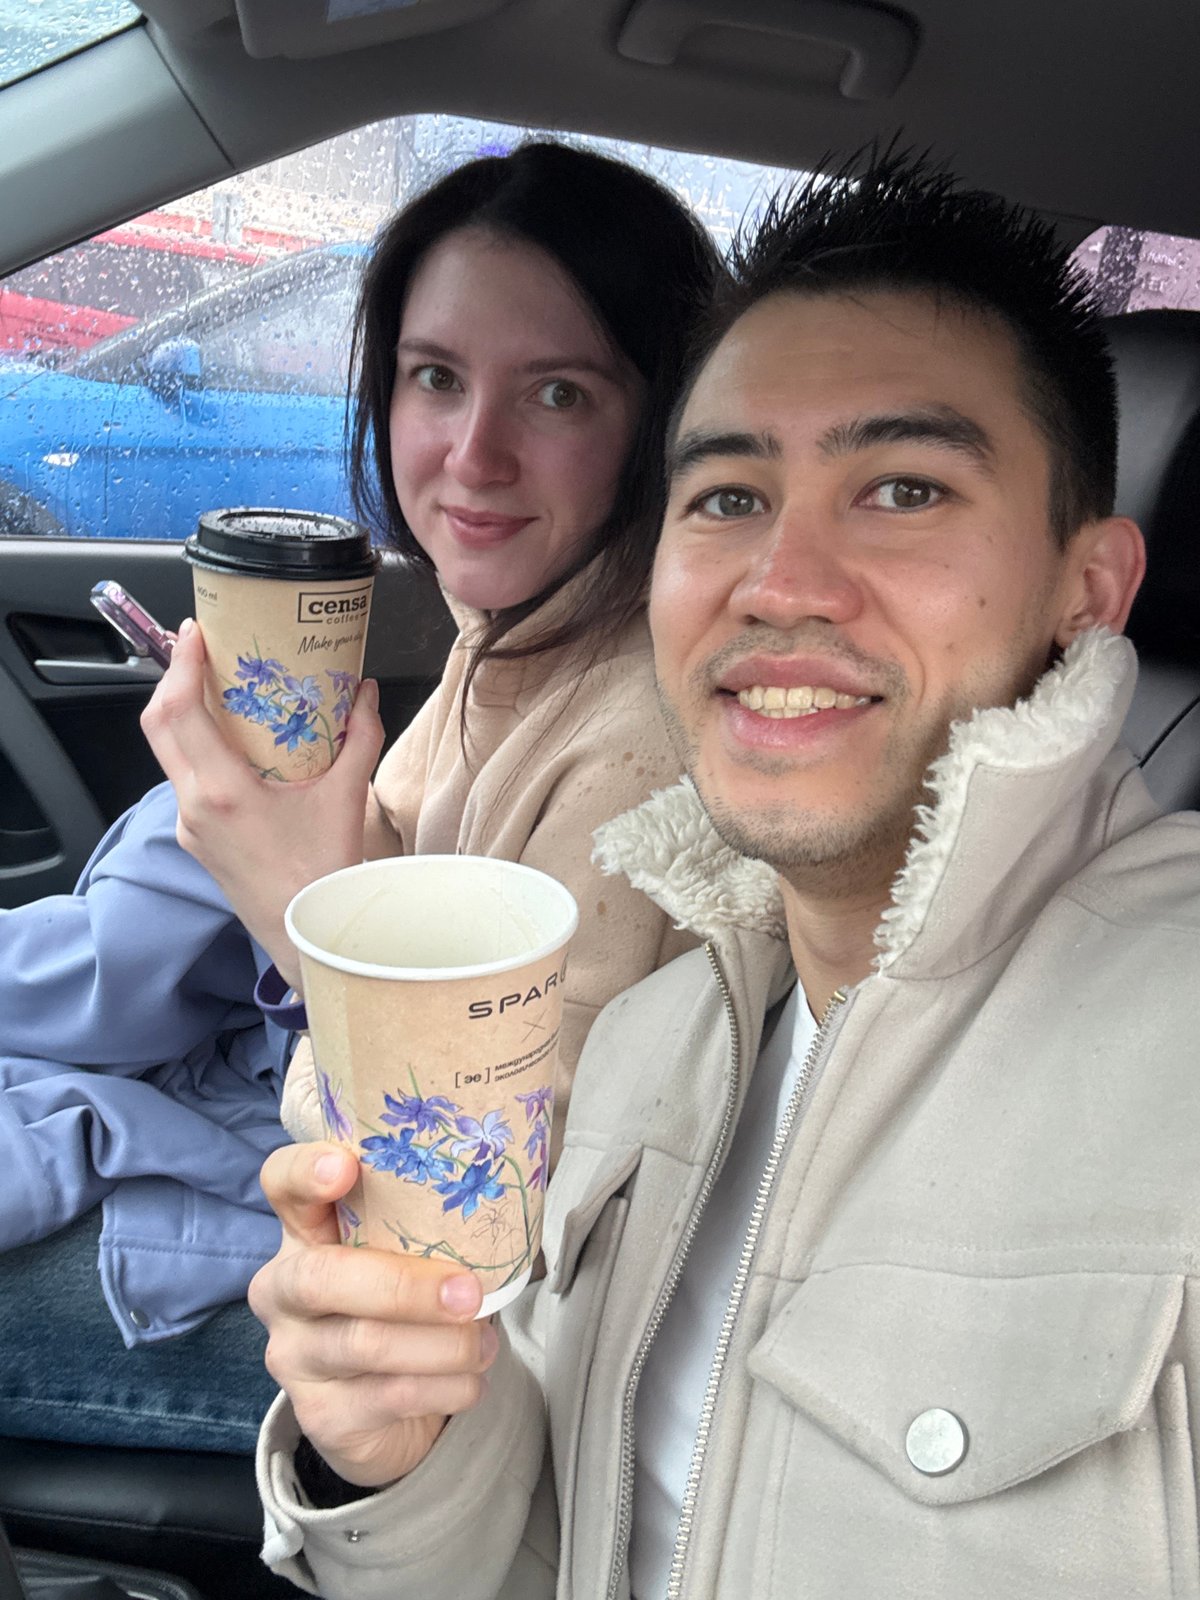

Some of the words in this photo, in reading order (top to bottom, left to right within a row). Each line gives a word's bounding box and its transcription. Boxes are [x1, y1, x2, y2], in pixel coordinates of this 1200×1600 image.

[308, 595, 367, 615] censa
[326, 614, 359, 625] coffee
[297, 635, 334, 655] Make
